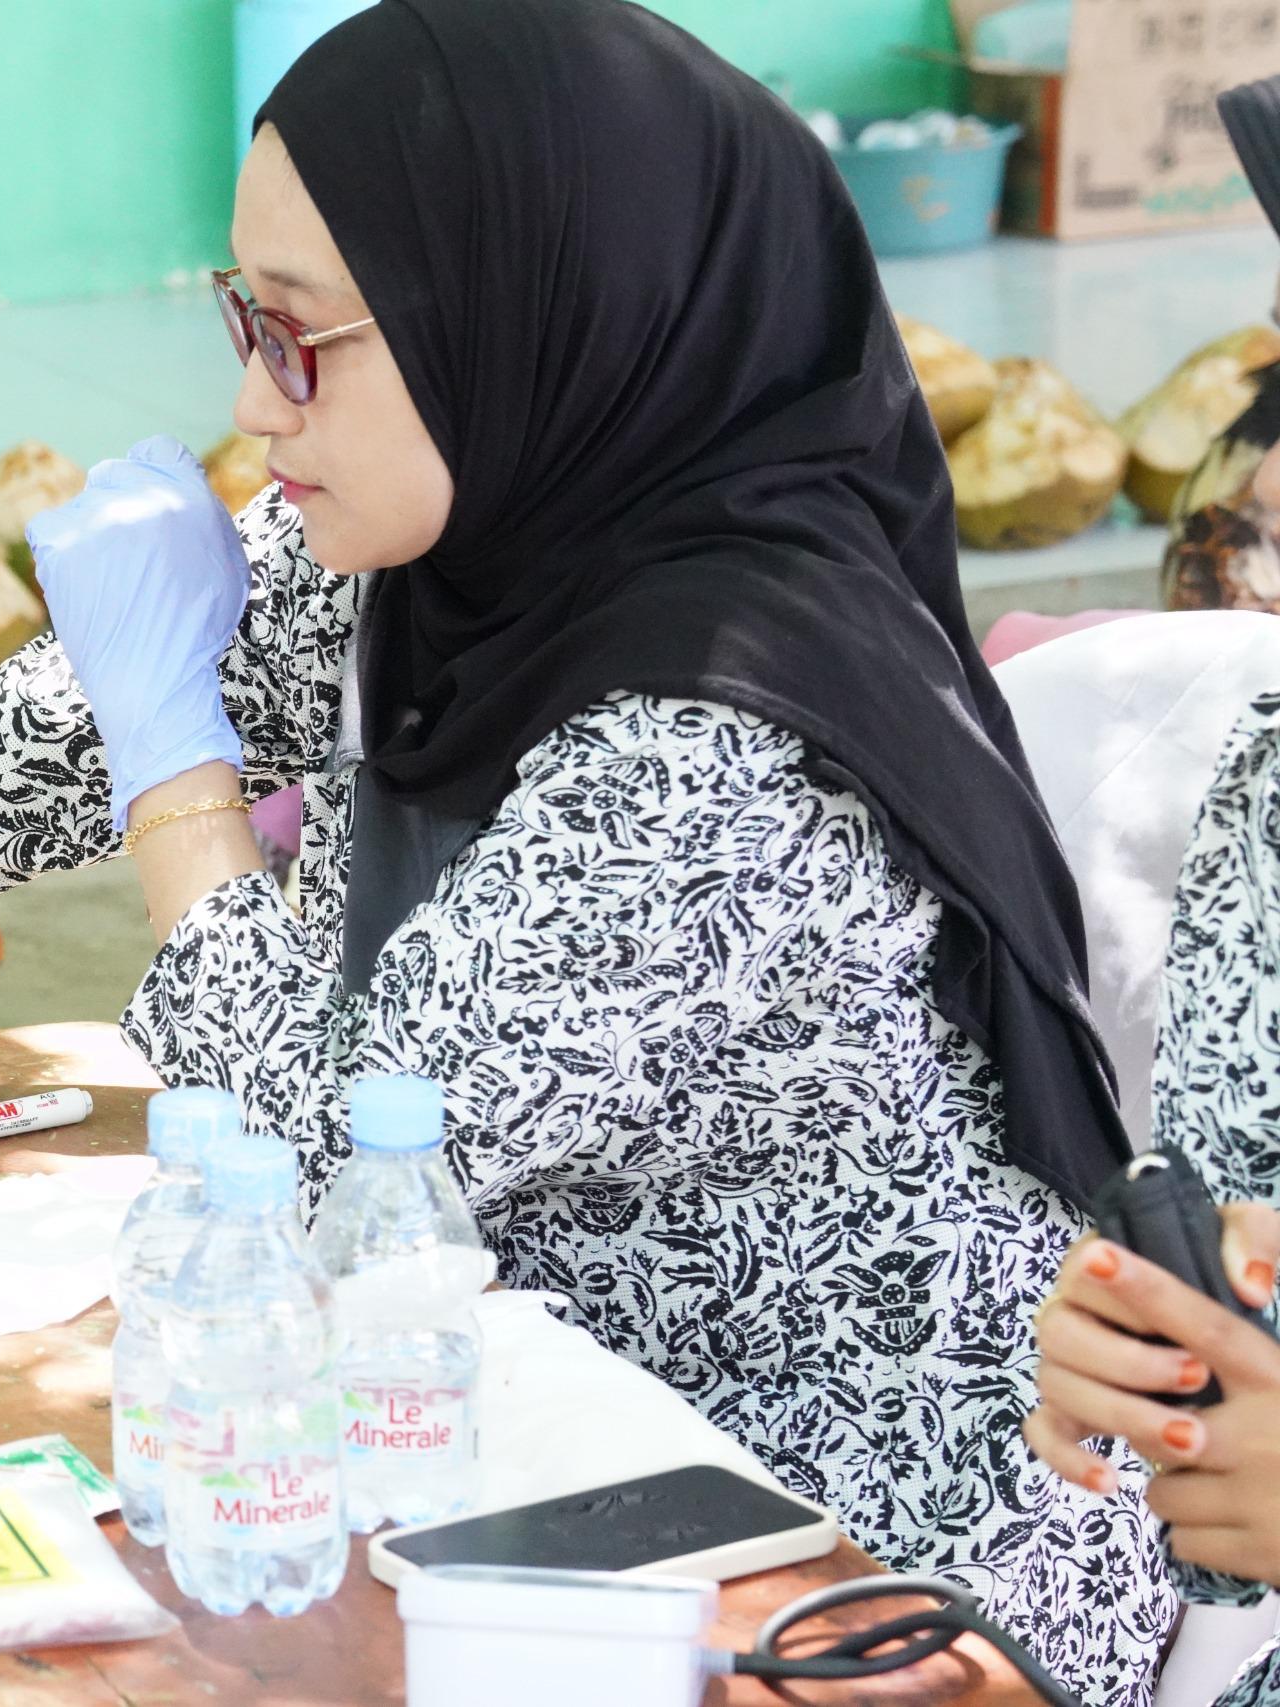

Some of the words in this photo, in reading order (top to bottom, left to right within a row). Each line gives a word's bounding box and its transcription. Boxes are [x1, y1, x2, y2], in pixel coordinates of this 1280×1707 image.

[388, 1395, 422, 1425] Le
[270, 1471, 304, 1499] Le
[214, 1489, 331, 1526] Minerale
